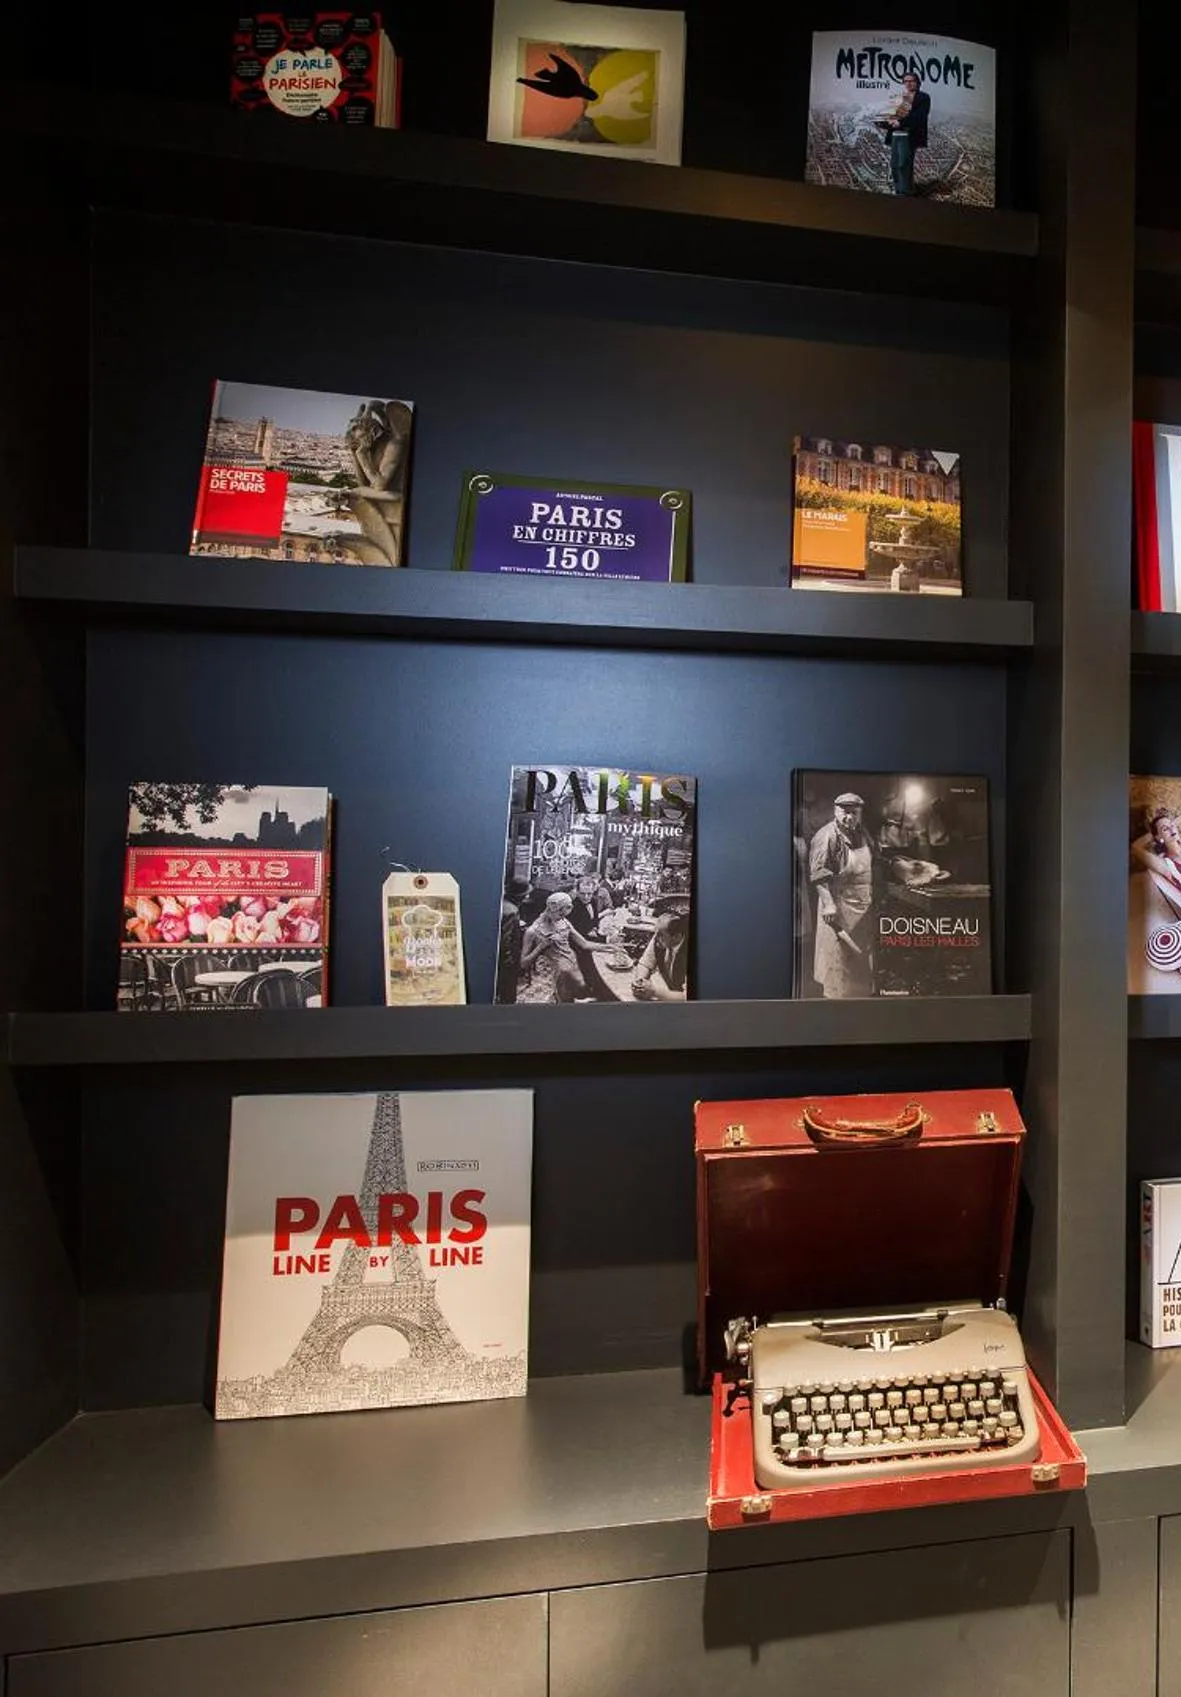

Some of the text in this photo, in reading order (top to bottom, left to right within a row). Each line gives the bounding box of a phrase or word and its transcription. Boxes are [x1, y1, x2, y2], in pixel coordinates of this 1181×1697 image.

[271, 59, 287, 74] JE
[293, 58, 333, 70] PARLE
[836, 46, 975, 90] METRONOME
[269, 77, 337, 90] PARISIEN
[211, 468, 264, 483] SECRETS
[210, 479, 226, 490] DE
[229, 480, 266, 493] PARIS
[529, 502, 624, 530] PARIS
[512, 525, 636, 548] EN CHIFFRES
[546, 546, 600, 571] 150
[524, 768, 687, 819] PARIS
[607, 819, 684, 839] mythique
[165, 859, 289, 879] PARIS
[880, 917, 979, 935] DOISNEAU
[272, 1189, 488, 1252] PARIS
[272, 1247, 483, 1276] LINE BY LINE
[1163, 1319, 1176, 1333] LA
